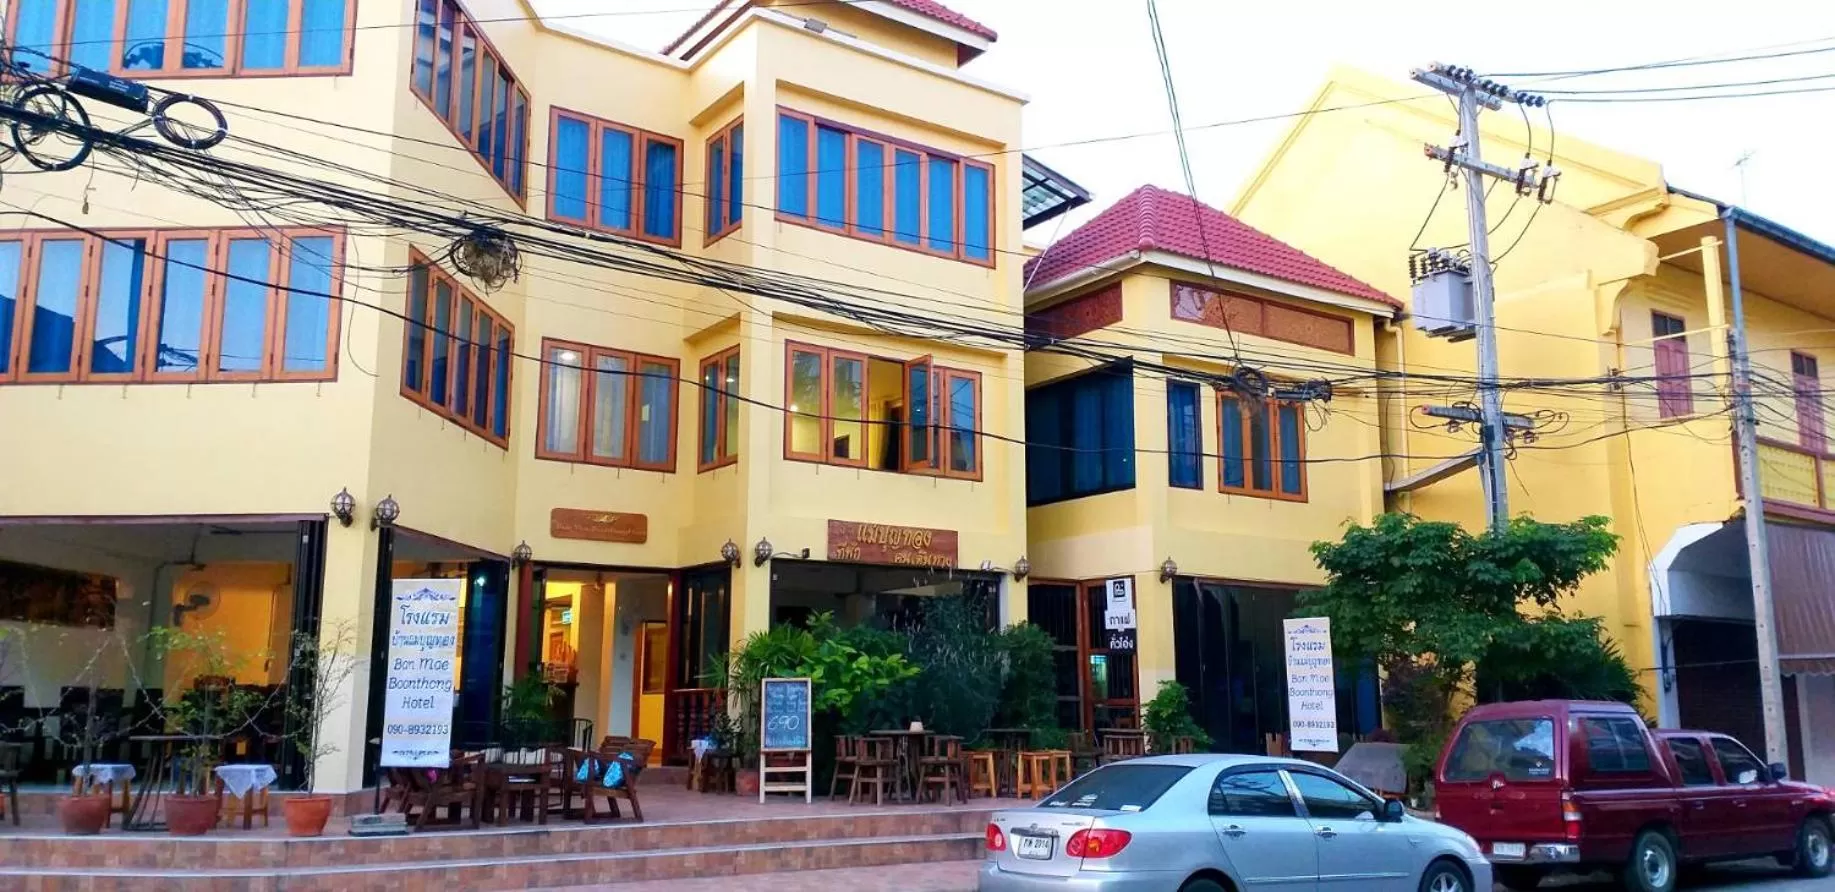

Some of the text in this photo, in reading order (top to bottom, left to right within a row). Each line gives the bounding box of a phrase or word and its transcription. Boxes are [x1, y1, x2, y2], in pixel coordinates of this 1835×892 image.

[857, 524, 933, 553] แม่บุญทอง
[400, 604, 450, 625] โรงแรม
[1110, 612, 1131, 625] กาแฟ
[392, 629, 456, 651] บ้านแม่บุญทอง
[1290, 636, 1326, 651] โรงแรม
[393, 657, 449, 671] Ban Mae
[388, 677, 452, 692] Boonthong
[401, 696, 435, 709] Hotel
[1301, 701, 1324, 711] Hotel
